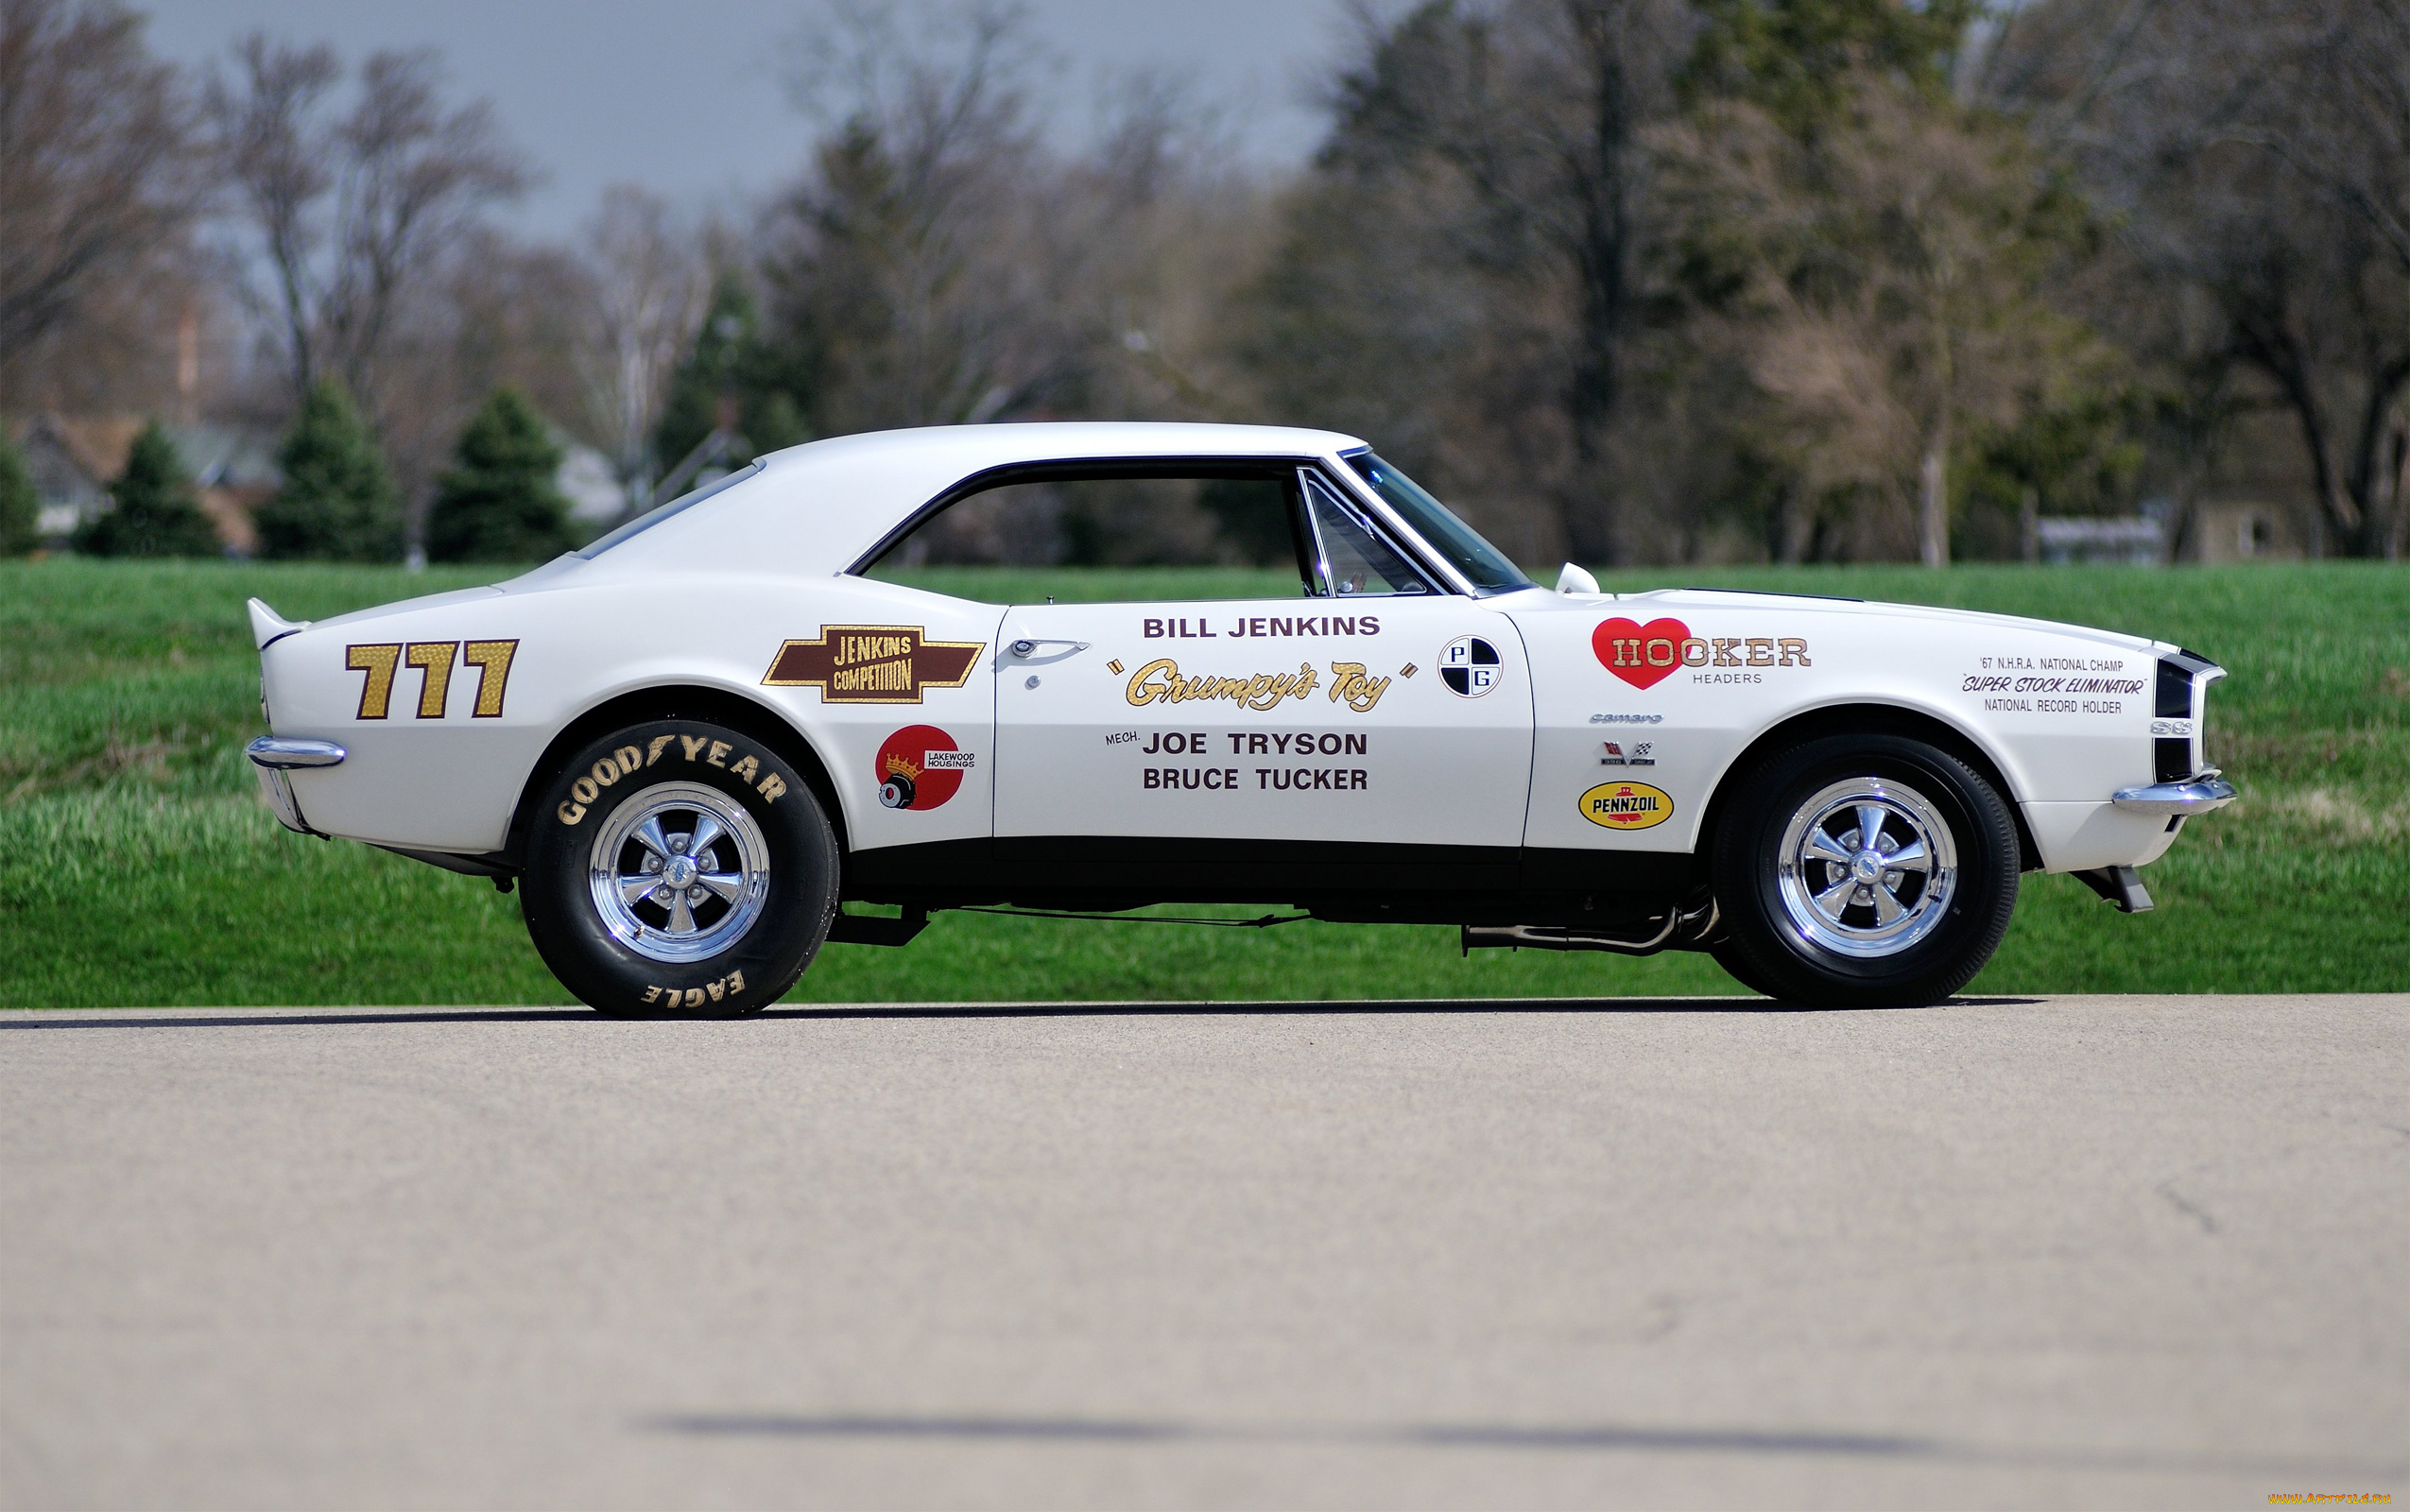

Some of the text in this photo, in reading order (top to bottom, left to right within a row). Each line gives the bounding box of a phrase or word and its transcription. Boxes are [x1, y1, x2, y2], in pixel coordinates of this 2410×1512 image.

[1143, 615, 1382, 640] BILL JENKINS
[833, 635, 912, 667] JENKINS
[1451, 645, 1466, 663] P
[1611, 637, 1812, 668] HOOKER
[1997, 658, 2036, 670] N.H.R.A.
[2040, 659, 2088, 671] NATIONAL
[2090, 659, 2124, 672] CHAMP
[345, 639, 521, 720] 777
[833, 658, 913, 692] COMPETITION
[1474, 670, 1490, 688] G
[1693, 673, 1763, 684] HEADERS
[2014, 677, 2066, 693] STOCK
[1985, 698, 2122, 714] NATIONAL RECORD HOLDER
[2150, 720, 2193, 735] SS
[1105, 730, 1369, 756] MECH. JOE TRYSON
[928, 752, 975, 761] LAKEWOOD
[928, 760, 975, 768] HOUSINGS
[1143, 768, 1369, 791] BRUCE TUCKER
[1592, 797, 1660, 814] PENNZOIL
[640, 970, 746, 1008] EAGLE
